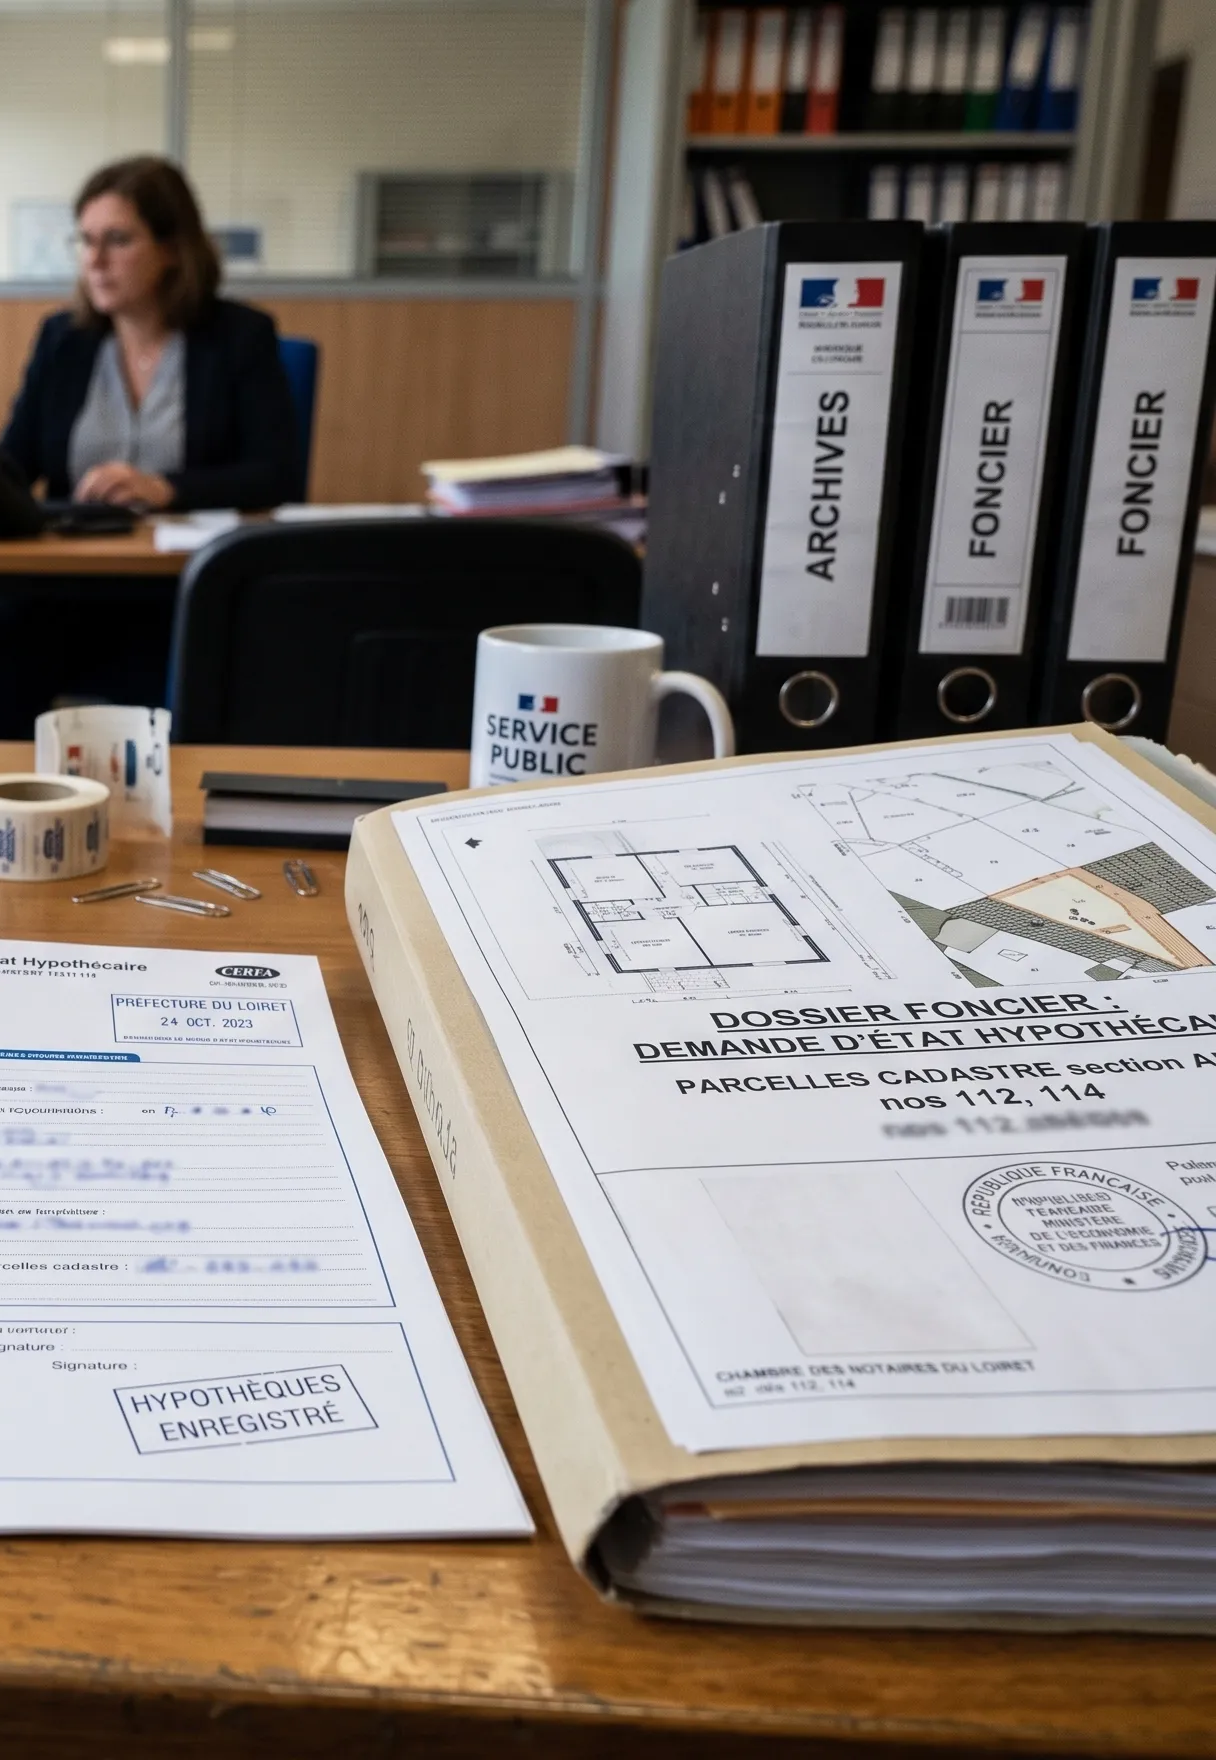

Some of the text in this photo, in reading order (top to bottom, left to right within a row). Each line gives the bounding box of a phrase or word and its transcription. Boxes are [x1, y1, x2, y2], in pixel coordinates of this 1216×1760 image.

[805, 391, 850, 582] ARCHIVES
[969, 399, 1014, 558] FONCIER
[1117, 390, 1166, 557] FONCIER
[486, 714, 598, 747] SERVICE
[491, 744, 587, 776] PUBLIC
[23, 957, 148, 972] Hypothécaire
[160, 1016, 254, 1029] 24 OCT. 2023
[212, 1000, 232, 1011] DU
[238, 1001, 288, 1012] LOIRET
[709, 1004, 893, 1030] DOSSIER
[907, 993, 1091, 1022] FONCIER
[632, 1013, 1216, 1061] DEMANDE D'ÉTAT HYPOTHÉCA
[675, 1052, 1216, 1095] PARCELLES CADASTRE section A
[880, 1083, 1106, 1111] nos 112, 114
[52, 1261, 119, 1271] cadastre
[51, 1360, 128, 1372] Signature
[808, 1363, 845, 1376] DES
[849, 1361, 937, 1375] NOTAIRES
[130, 1373, 342, 1415] HYPOTHÈQUES
[159, 1402, 345, 1443] ENREGISTRÉ
